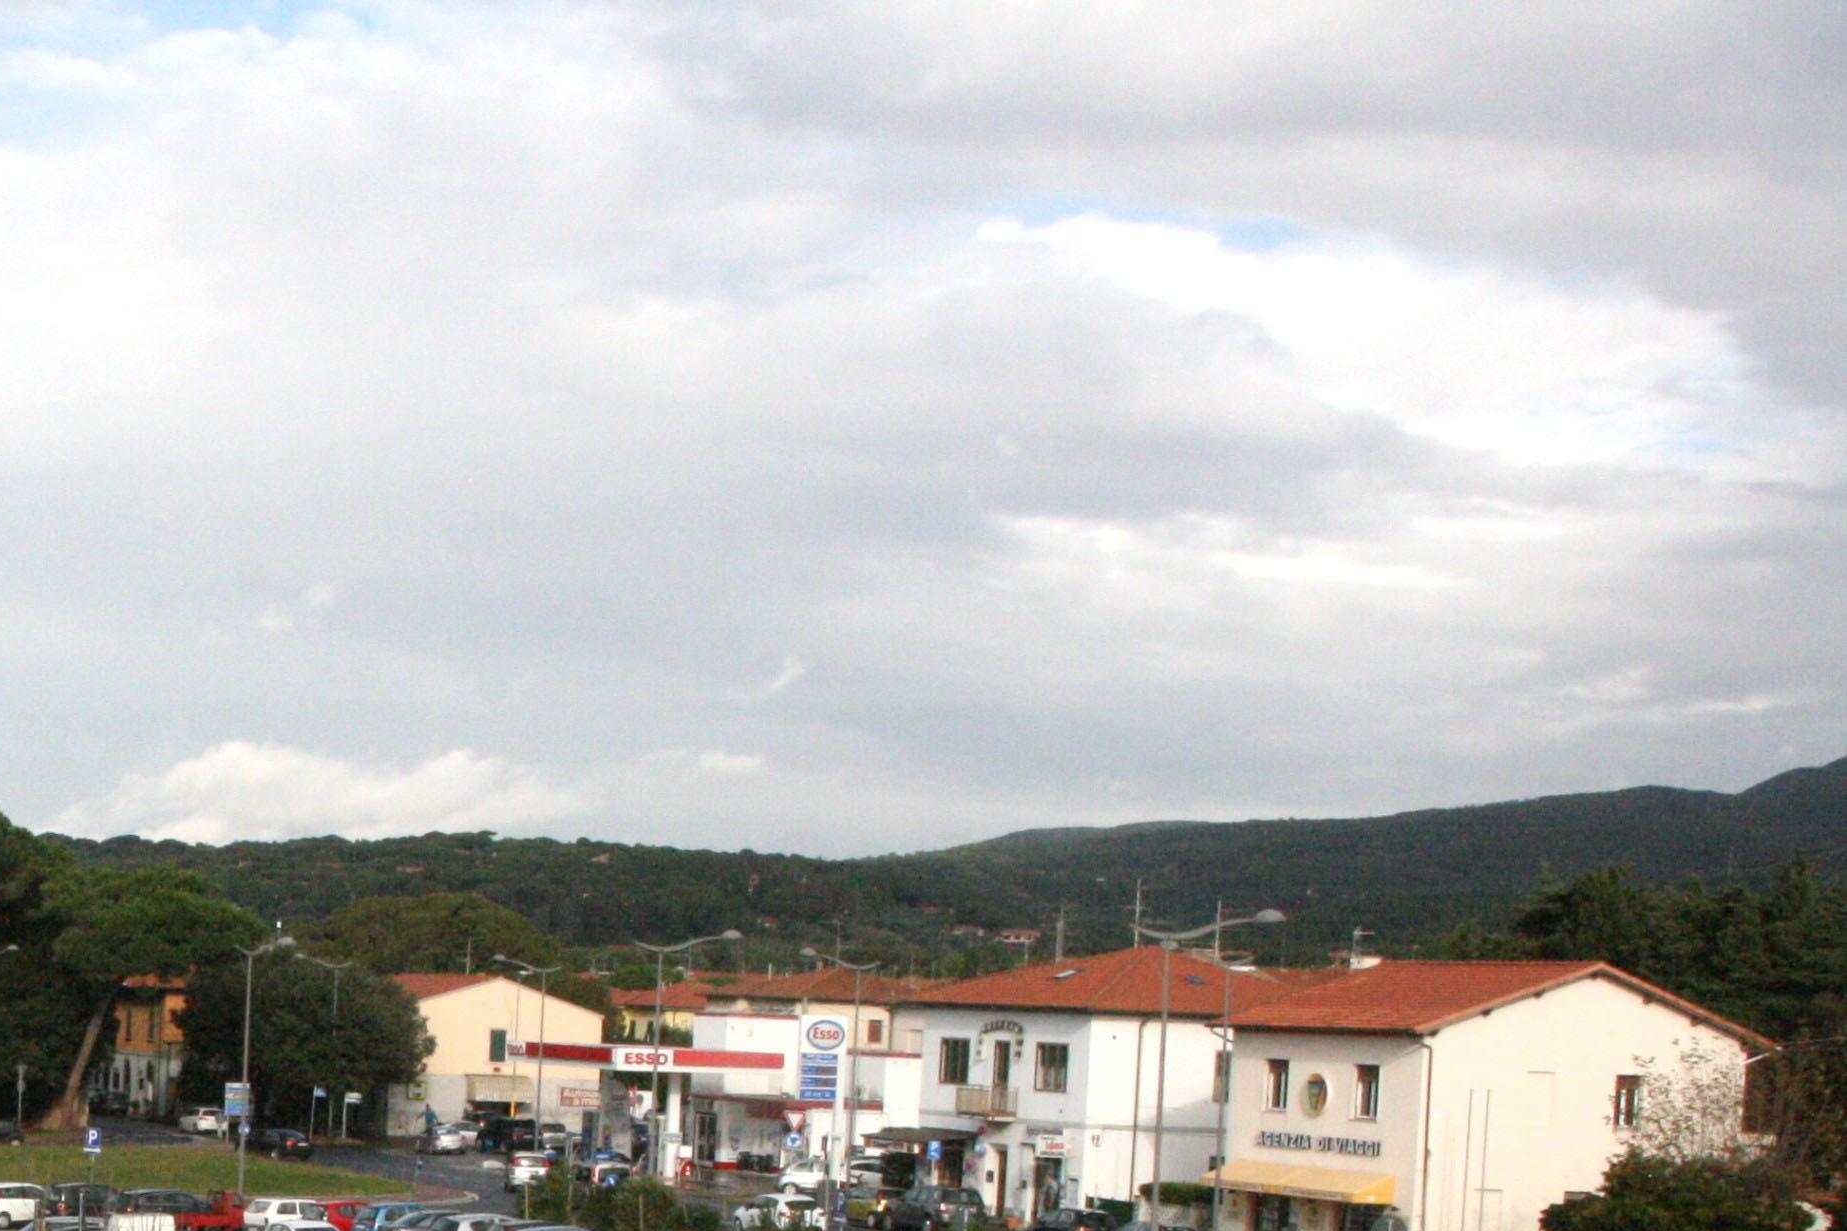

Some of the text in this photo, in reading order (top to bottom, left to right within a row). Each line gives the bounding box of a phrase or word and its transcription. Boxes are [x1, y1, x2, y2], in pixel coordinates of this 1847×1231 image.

[624, 1051, 668, 1066] ESSO
[89, 1129, 97, 1144] P
[1257, 1130, 1312, 1150] AGENZIA
